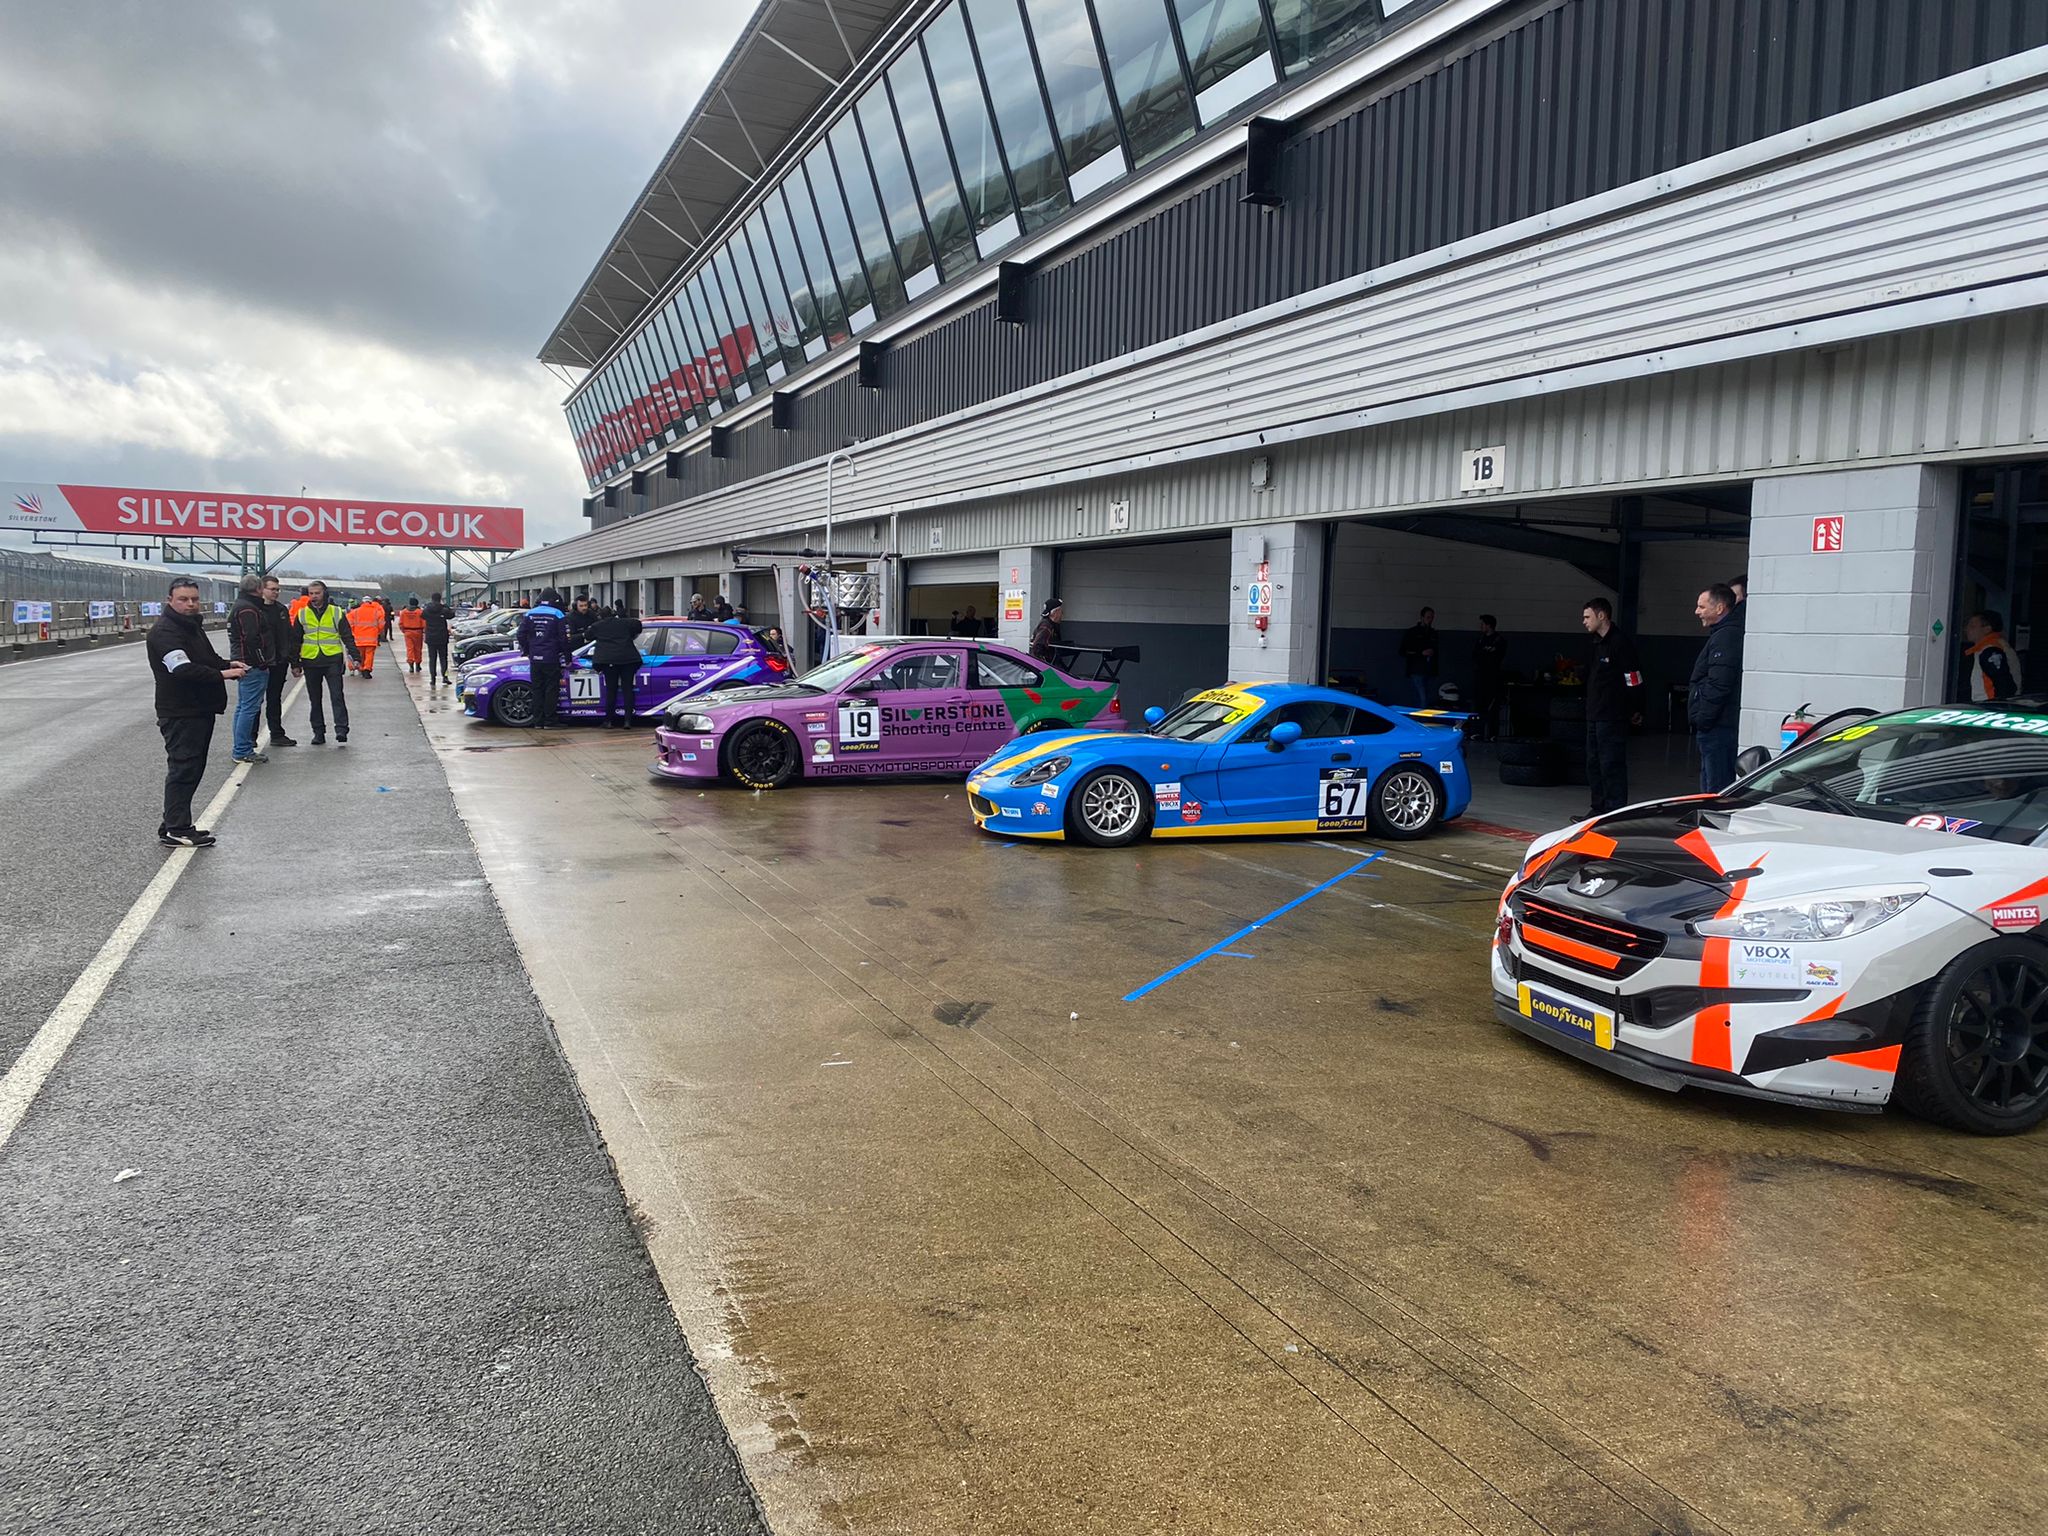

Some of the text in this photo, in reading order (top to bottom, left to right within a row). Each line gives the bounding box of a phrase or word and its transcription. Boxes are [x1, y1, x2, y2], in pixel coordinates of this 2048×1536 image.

[1472, 455, 1494, 481] 1B
[8, 514, 58, 523] SILVERSTONE
[117, 496, 486, 539] SILVERSTONE.CO.UK
[1114, 507, 1124, 525] 1C
[574, 678, 592, 697] 71
[881, 704, 1005, 722] SILVERSTONE
[764, 720, 788, 734] EAGLE
[849, 711, 872, 738] 19
[882, 720, 1006, 736] Shooting Centre
[840, 742, 879, 751] GOODYEAR
[1325, 782, 1361, 816] 67
[1319, 818, 1364, 828] GOODYEAR
[1993, 907, 2038, 920] MINTEX
[1743, 945, 1791, 959] VBOX
[1746, 957, 1792, 965] MOTORSPORT
[1532, 998, 1593, 1032] GOODYEAR
